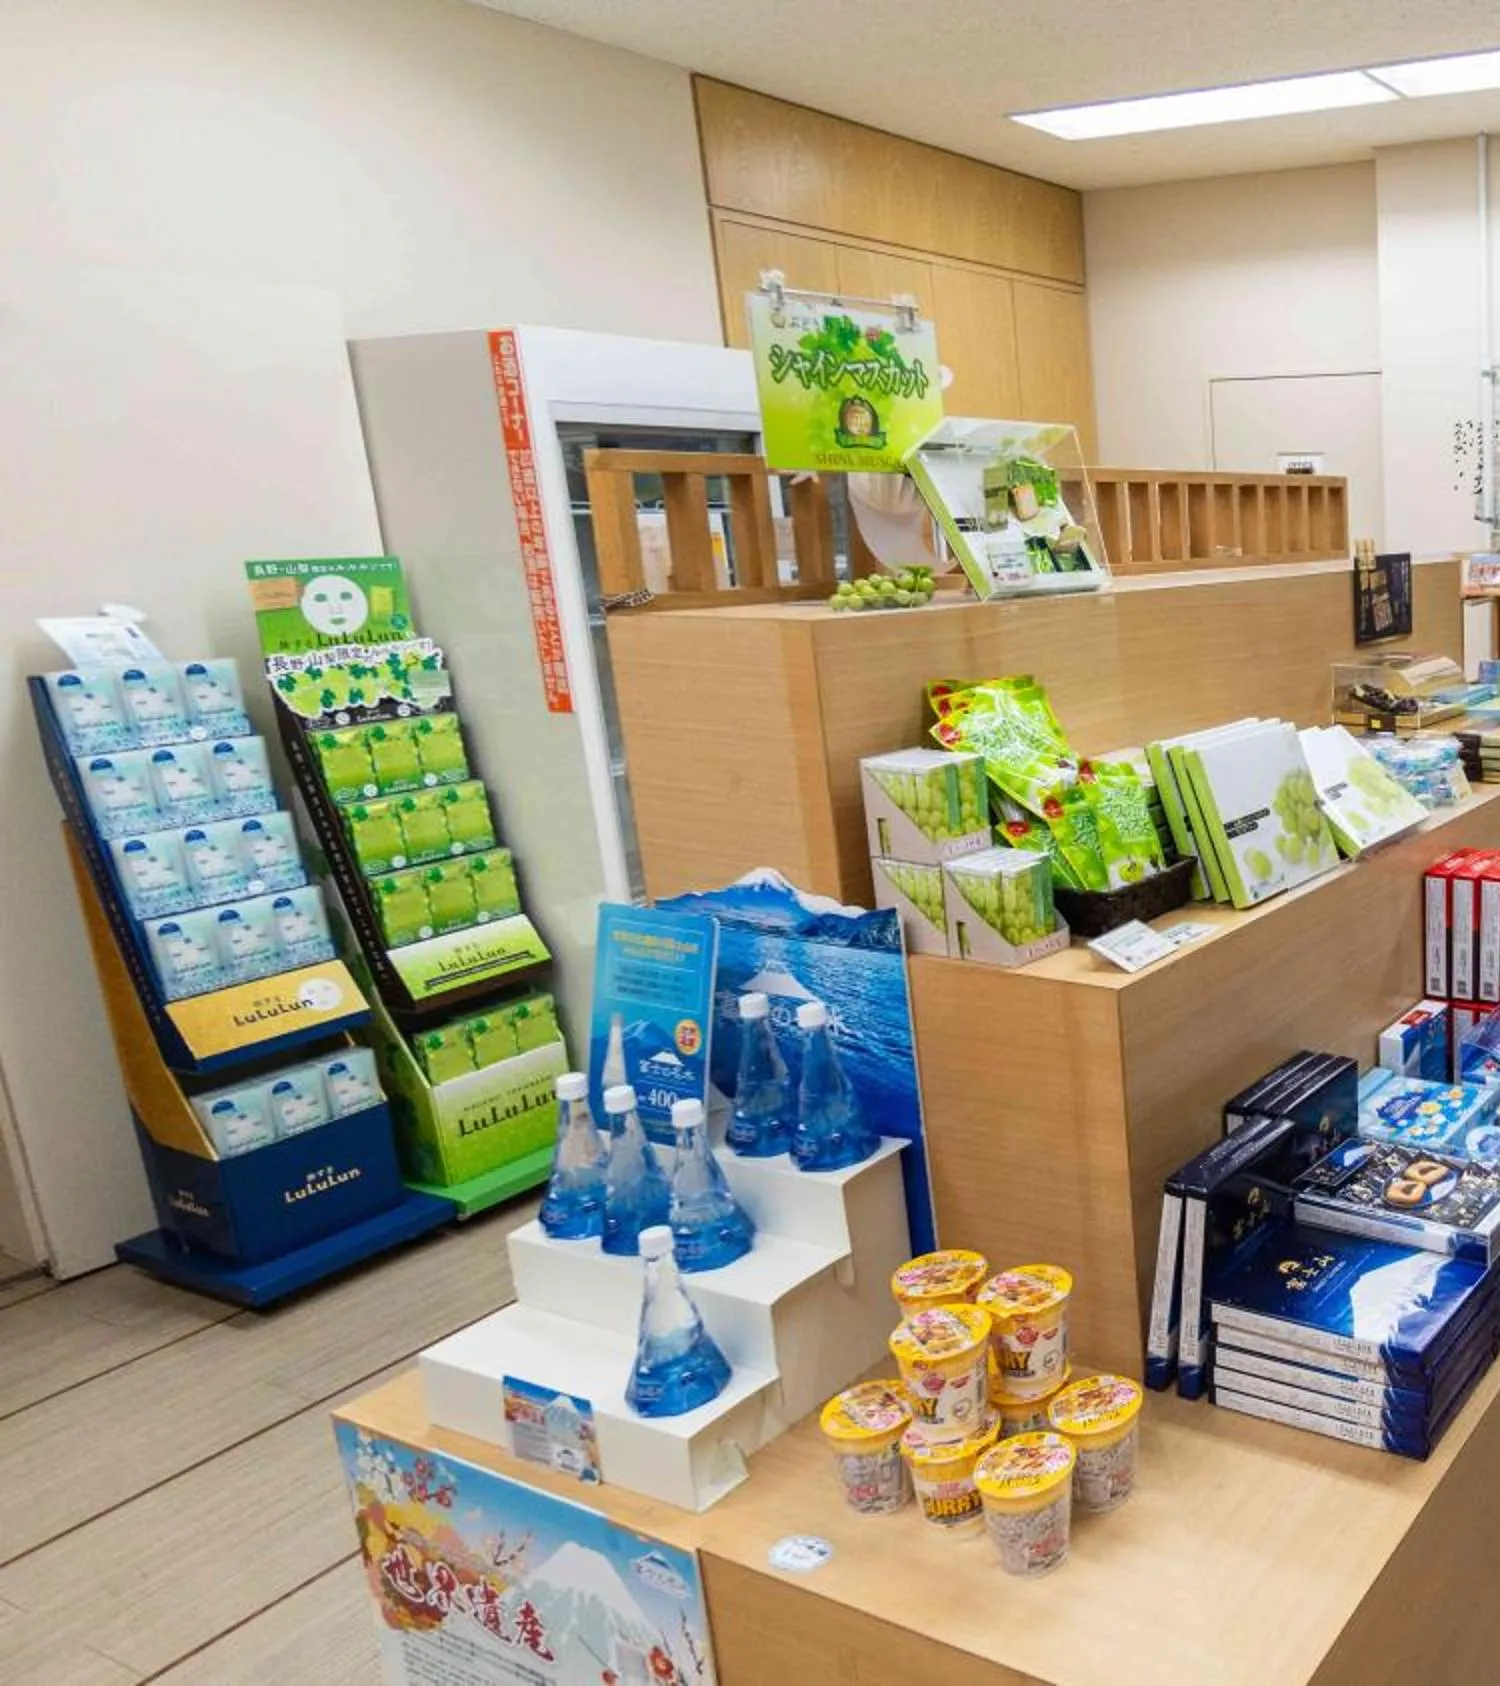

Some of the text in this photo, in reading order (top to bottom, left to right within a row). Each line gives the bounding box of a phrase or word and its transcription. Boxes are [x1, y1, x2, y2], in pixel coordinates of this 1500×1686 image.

[768, 343, 930, 400] シャインマスカット
[233, 999, 314, 1027] LuLuLun
[284, 1167, 361, 1203] LuLuLun
